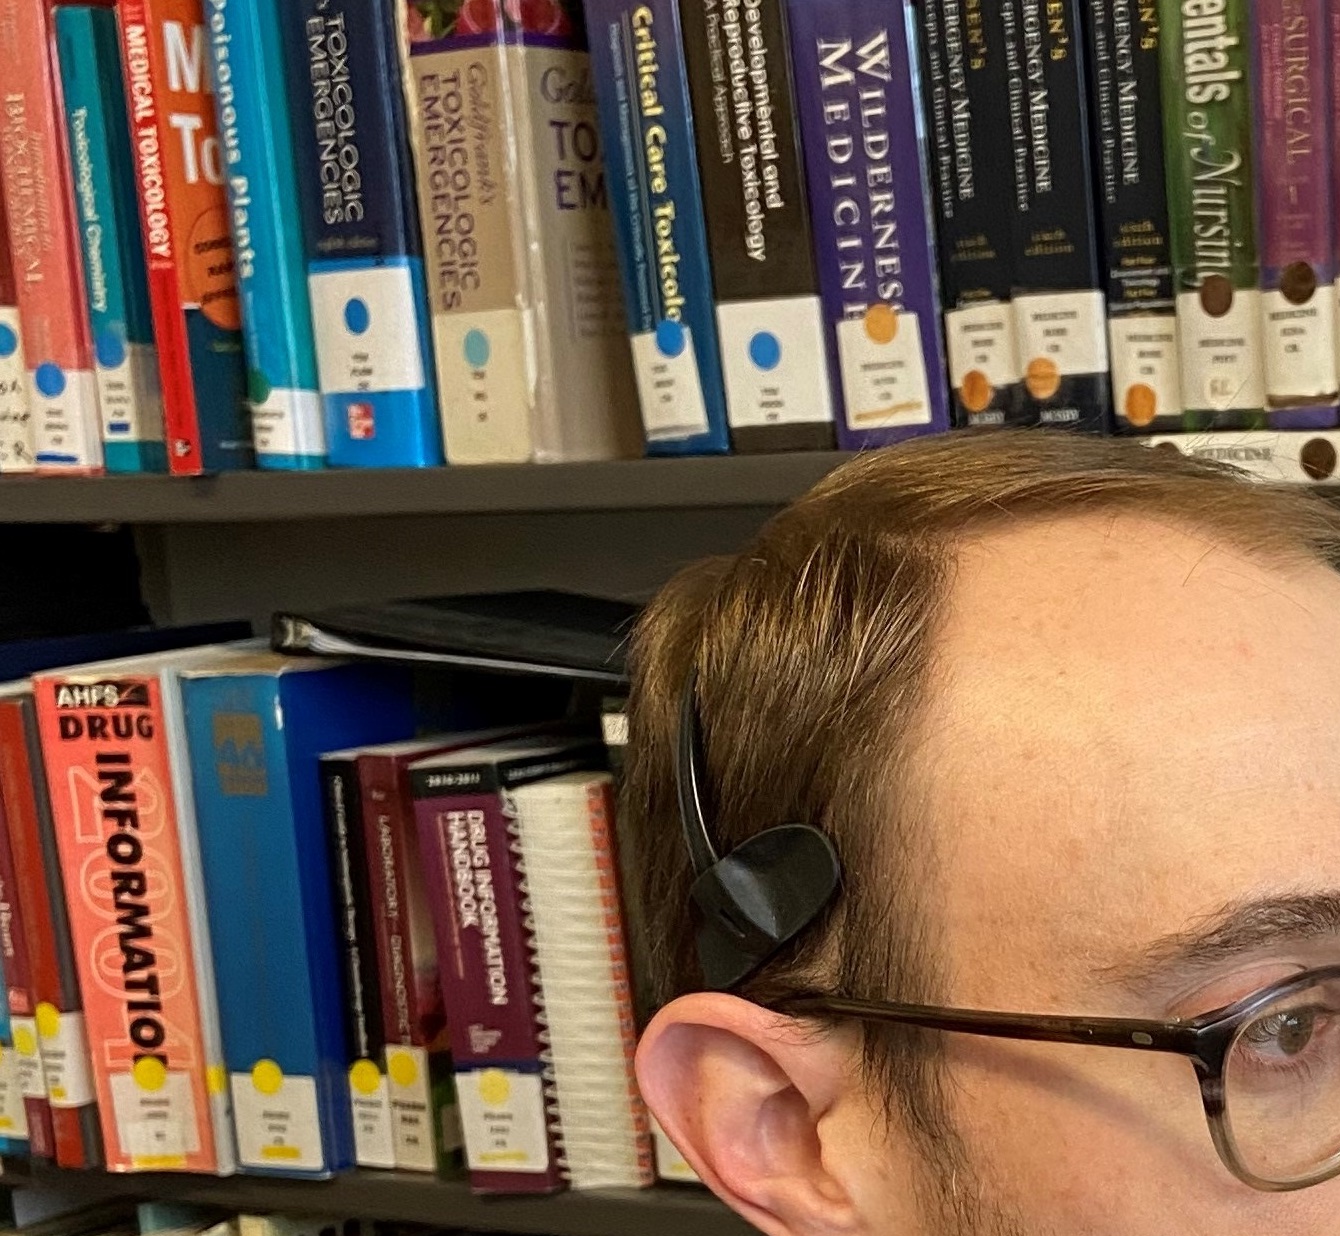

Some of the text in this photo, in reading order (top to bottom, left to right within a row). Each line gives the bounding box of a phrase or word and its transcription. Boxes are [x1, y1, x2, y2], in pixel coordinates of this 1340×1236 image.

[306, 16, 344, 225] EMERGENCIES
[325, 11, 364, 223] TOXICOLOGIC
[631, 6, 666, 117] Critical
[125, 24, 170, 258] MEDICAL TOXICOLOGY
[440, 71, 481, 291] TOXICOLOGIC
[645, 125, 668, 194] Care
[762, 164, 785, 210] and
[816, 38, 869, 319] MEDICINE
[856, 28, 905, 314] WILDERNES
[1181, 110, 1218, 146] of
[419, 74, 463, 312] EMERGENCIES
[739, 146, 767, 262] Toxicology
[57, 685, 120, 709] AHFS
[58, 712, 155, 742] DRUG
[446, 810, 479, 929] HANDBOOK
[466, 810, 490, 867] DRUG
[474, 870, 509, 1006] INFORMATION
